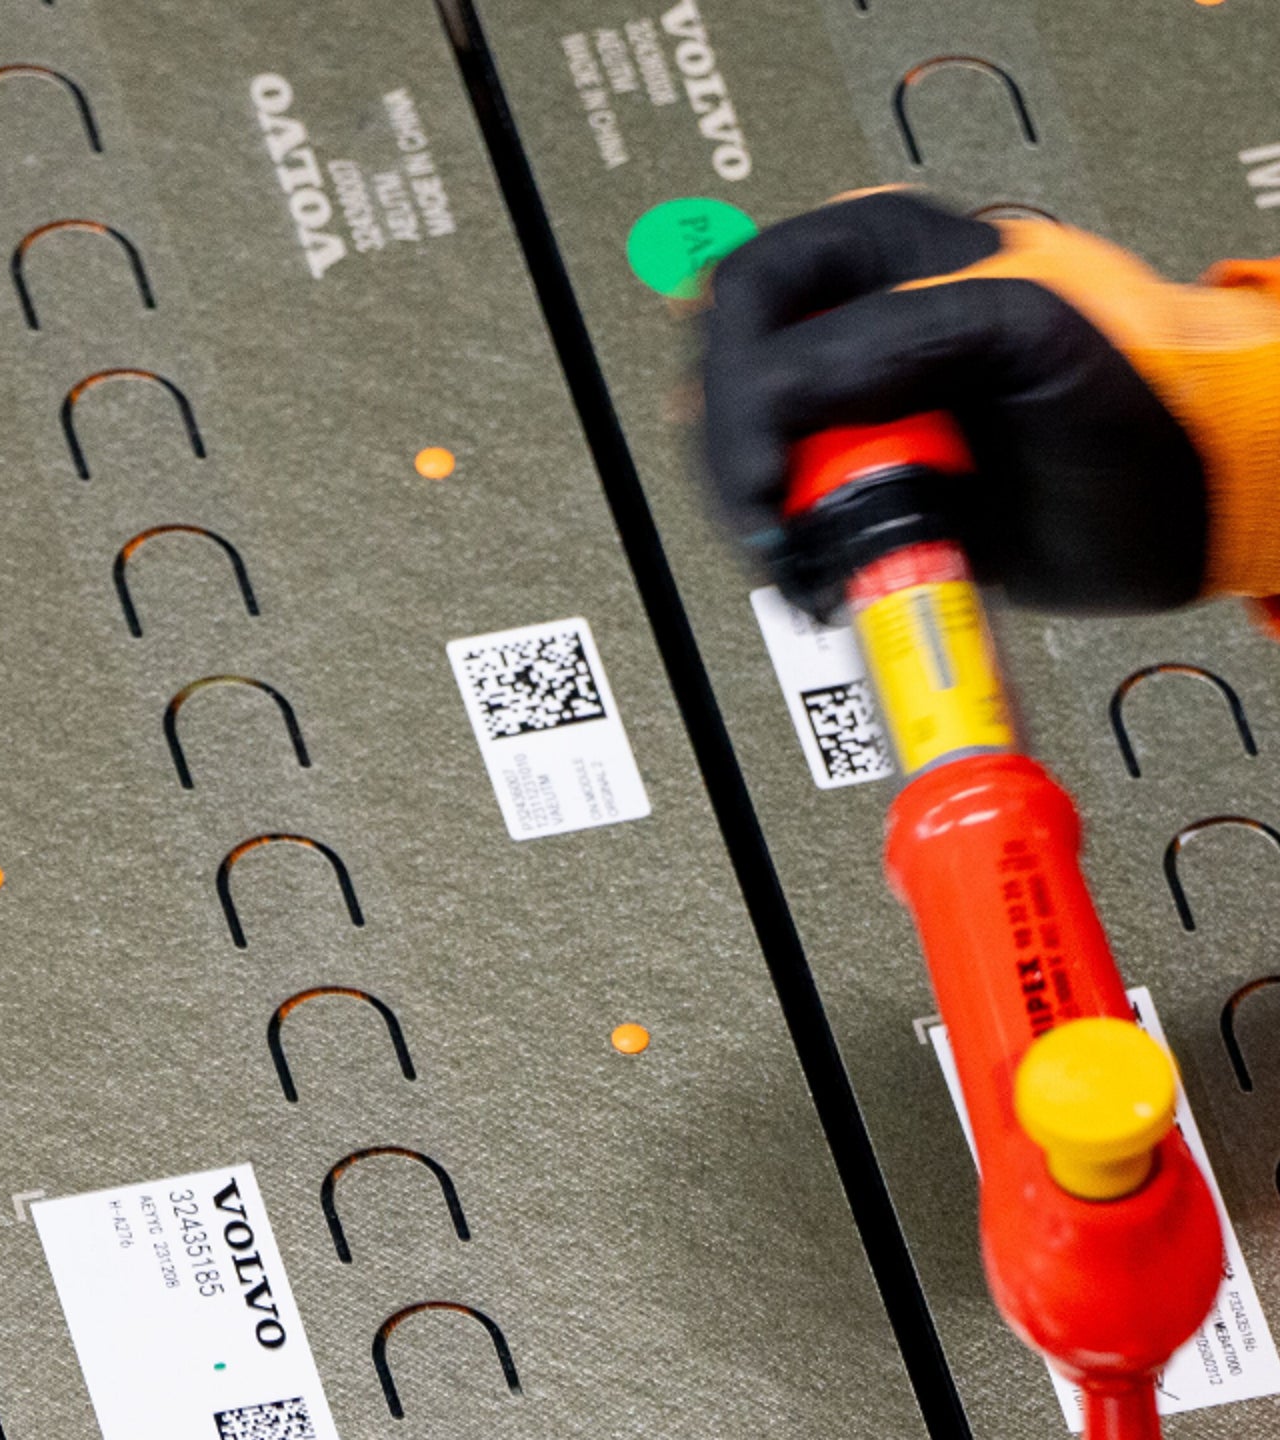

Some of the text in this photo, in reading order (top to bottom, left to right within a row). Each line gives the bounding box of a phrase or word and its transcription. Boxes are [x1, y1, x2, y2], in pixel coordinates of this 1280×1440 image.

[381, 87, 427, 152] CHINA
[579, 86, 612, 112] IN
[660, 0, 752, 181] VOLVO
[250, 73, 348, 280] VOLVO
[402, 150, 436, 177] IN
[588, 108, 632, 169] CHINA
[676, 214, 723, 270] PA
[140, 1196, 180, 1288] AEYYC 231208
[169, 1190, 225, 1297] 32435185
[213, 1177, 286, 1350] VOLVO
